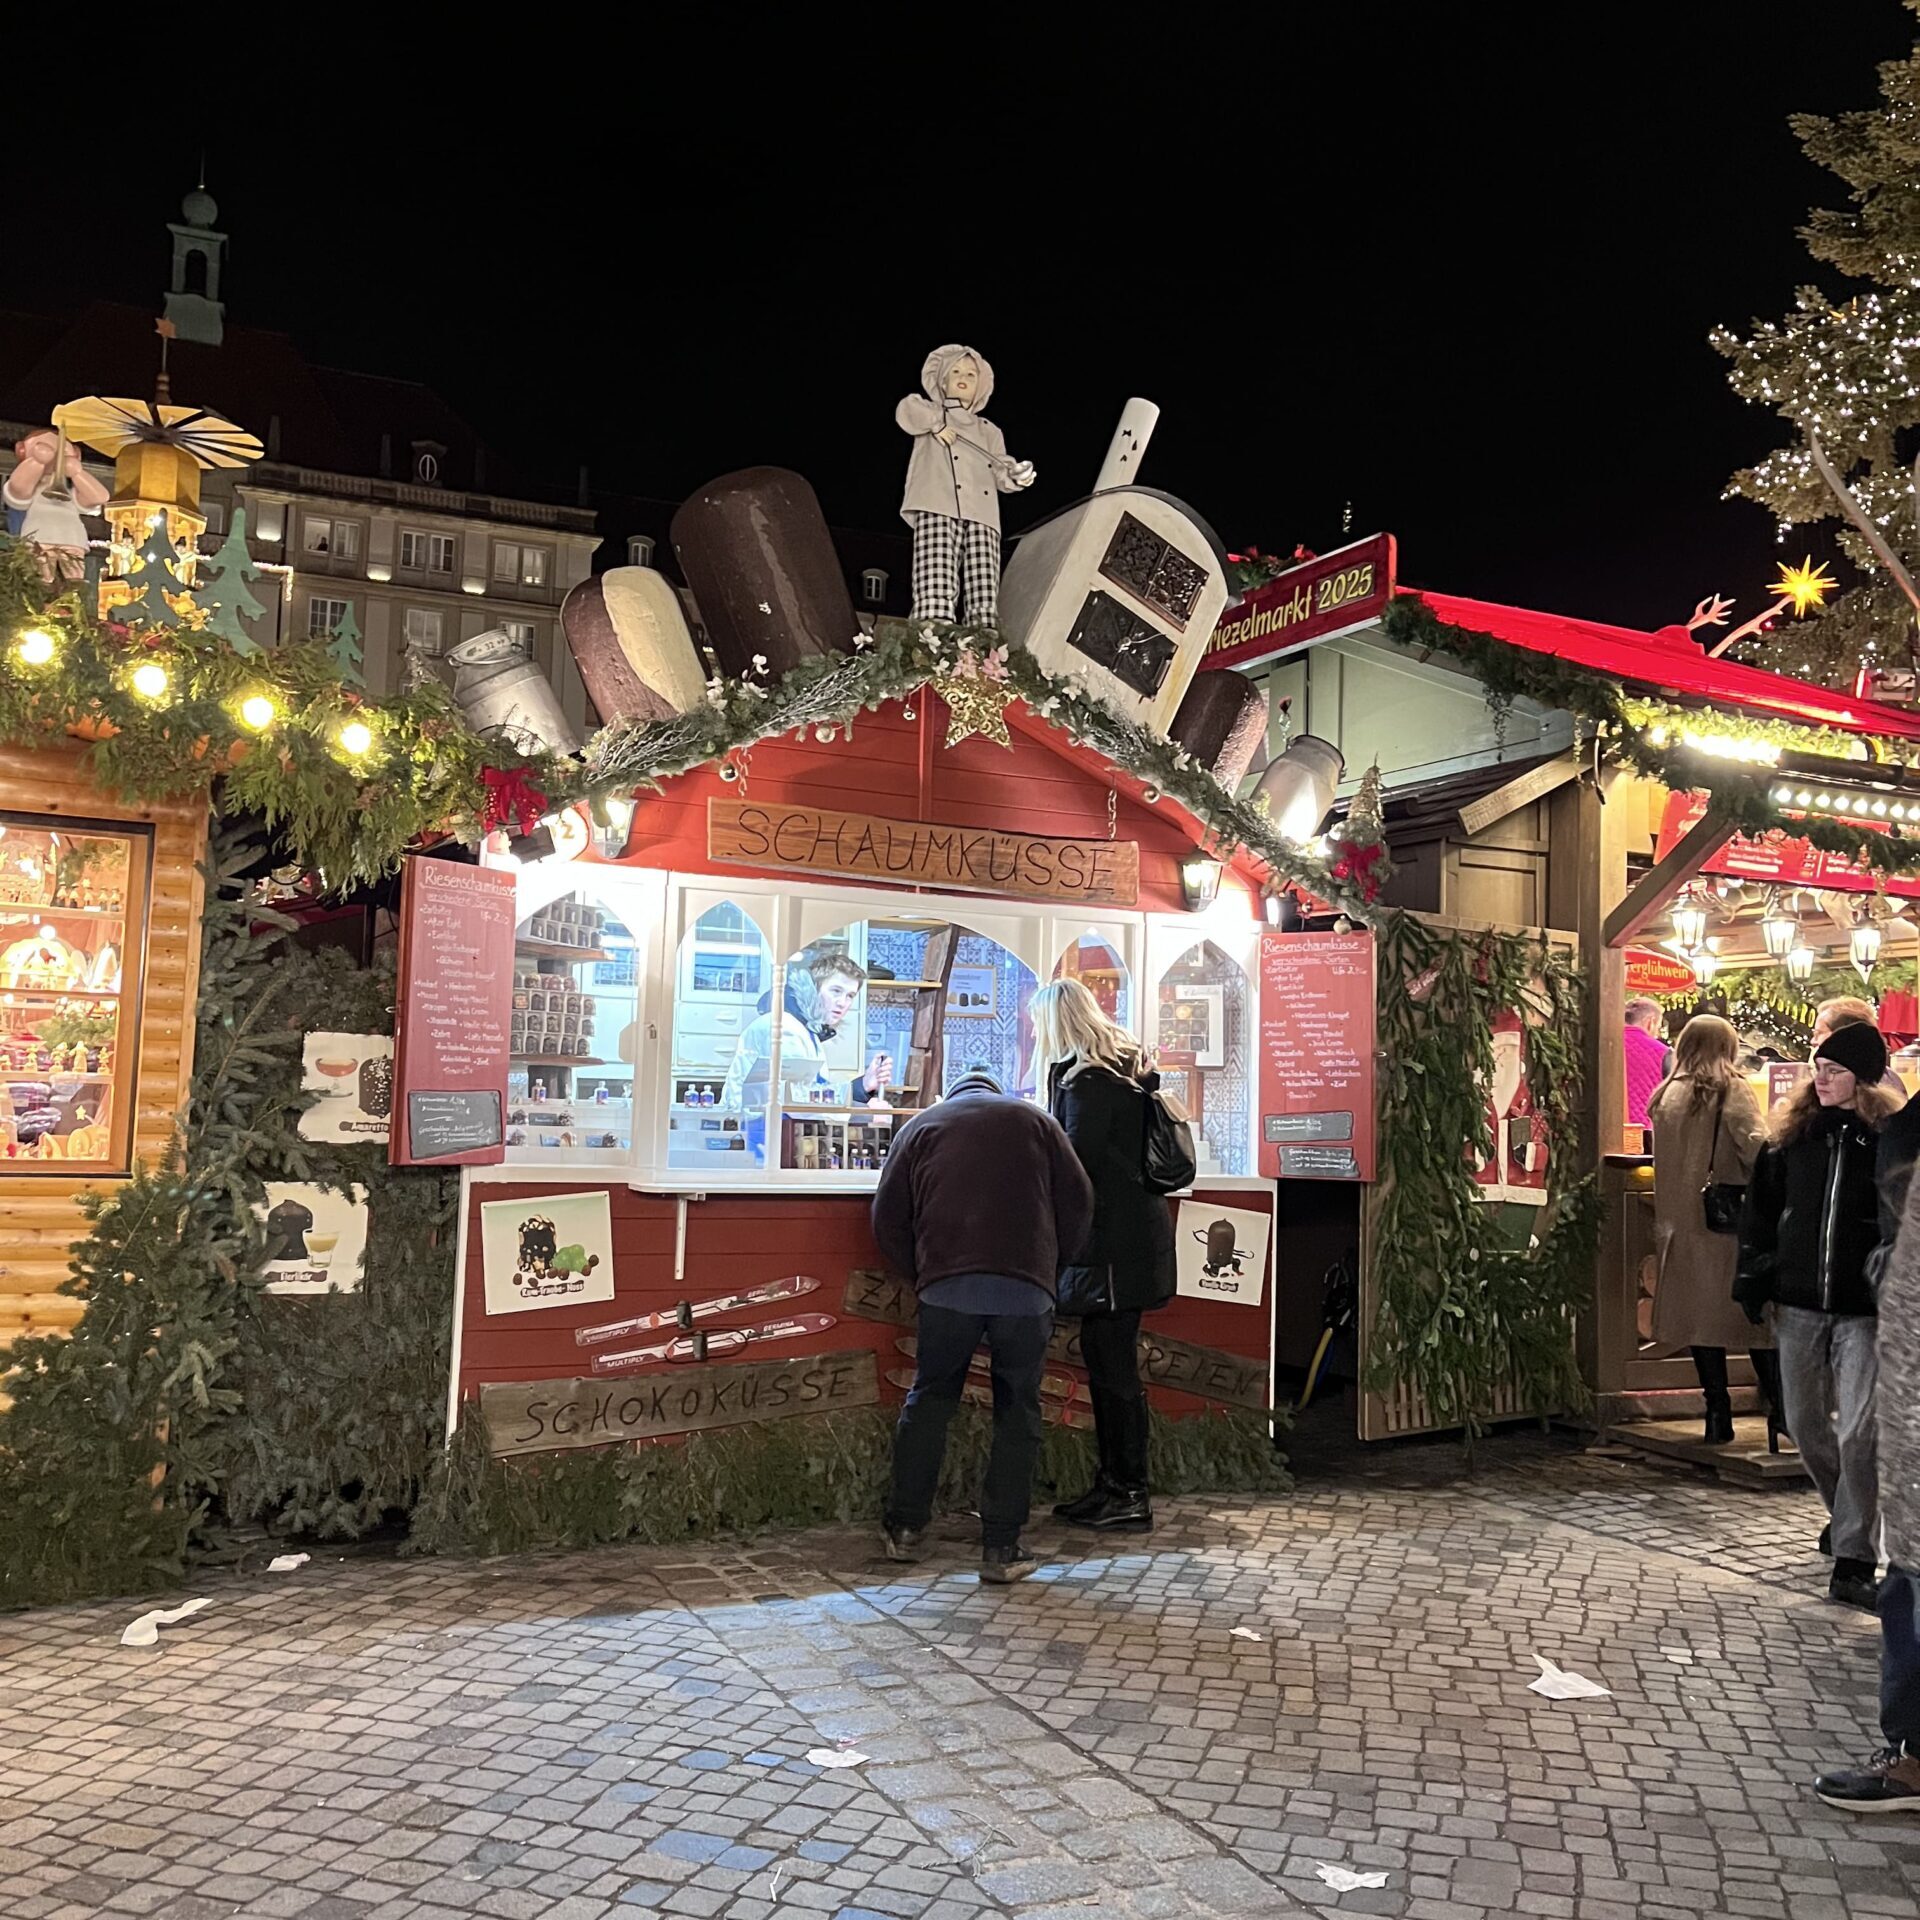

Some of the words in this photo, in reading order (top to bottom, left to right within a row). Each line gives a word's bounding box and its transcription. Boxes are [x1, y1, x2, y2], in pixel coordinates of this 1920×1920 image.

[1203, 584, 1312, 657] riezelmarkt
[1318, 564, 1373, 610] 2025
[737, 807, 1117, 892] SCHAUMKÜSSE
[1628, 959, 1689, 980] erglühwein
[350, 1122, 390, 1132] Amaretto
[606, 1355, 645, 1369] MULTIPLY
[515, 1366, 854, 1443] SCHOKOKÜSSE
